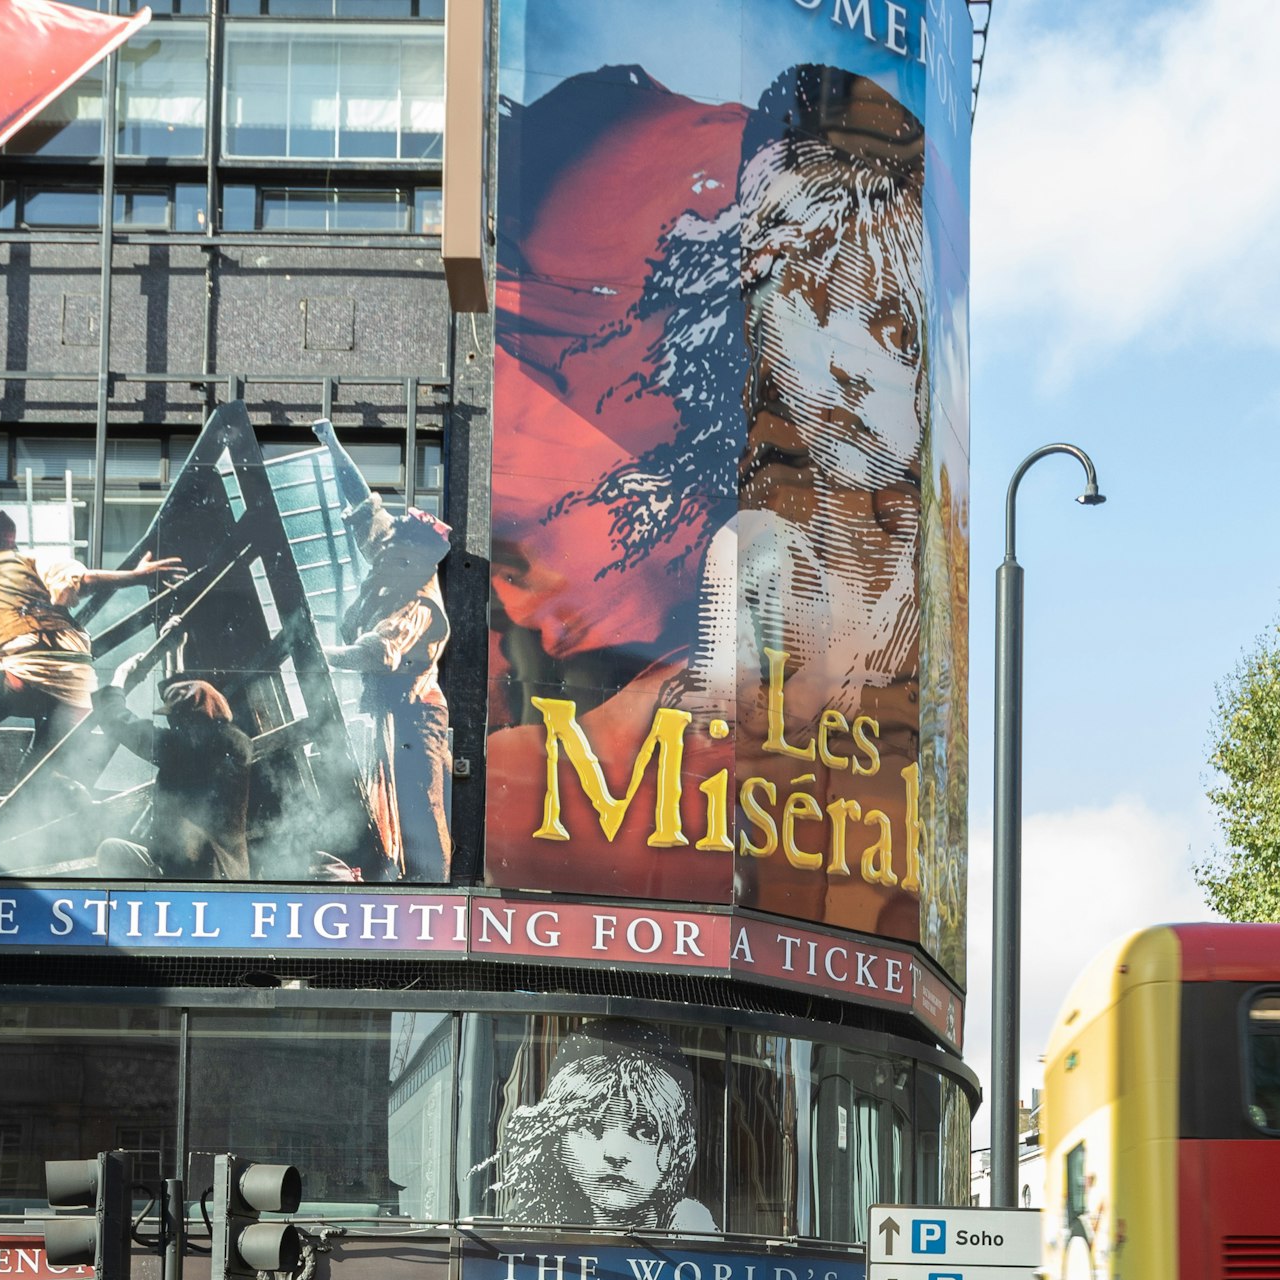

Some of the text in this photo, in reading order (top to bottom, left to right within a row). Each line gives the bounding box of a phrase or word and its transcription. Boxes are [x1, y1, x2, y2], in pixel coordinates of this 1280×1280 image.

[761, 647, 880, 776] Les
[49, 898, 221, 938] STILL
[251, 902, 560, 948] FIGHTING
[592, 914, 705, 958] FOR
[731, 925, 755, 964] A
[956, 1230, 1004, 1247] Soho
